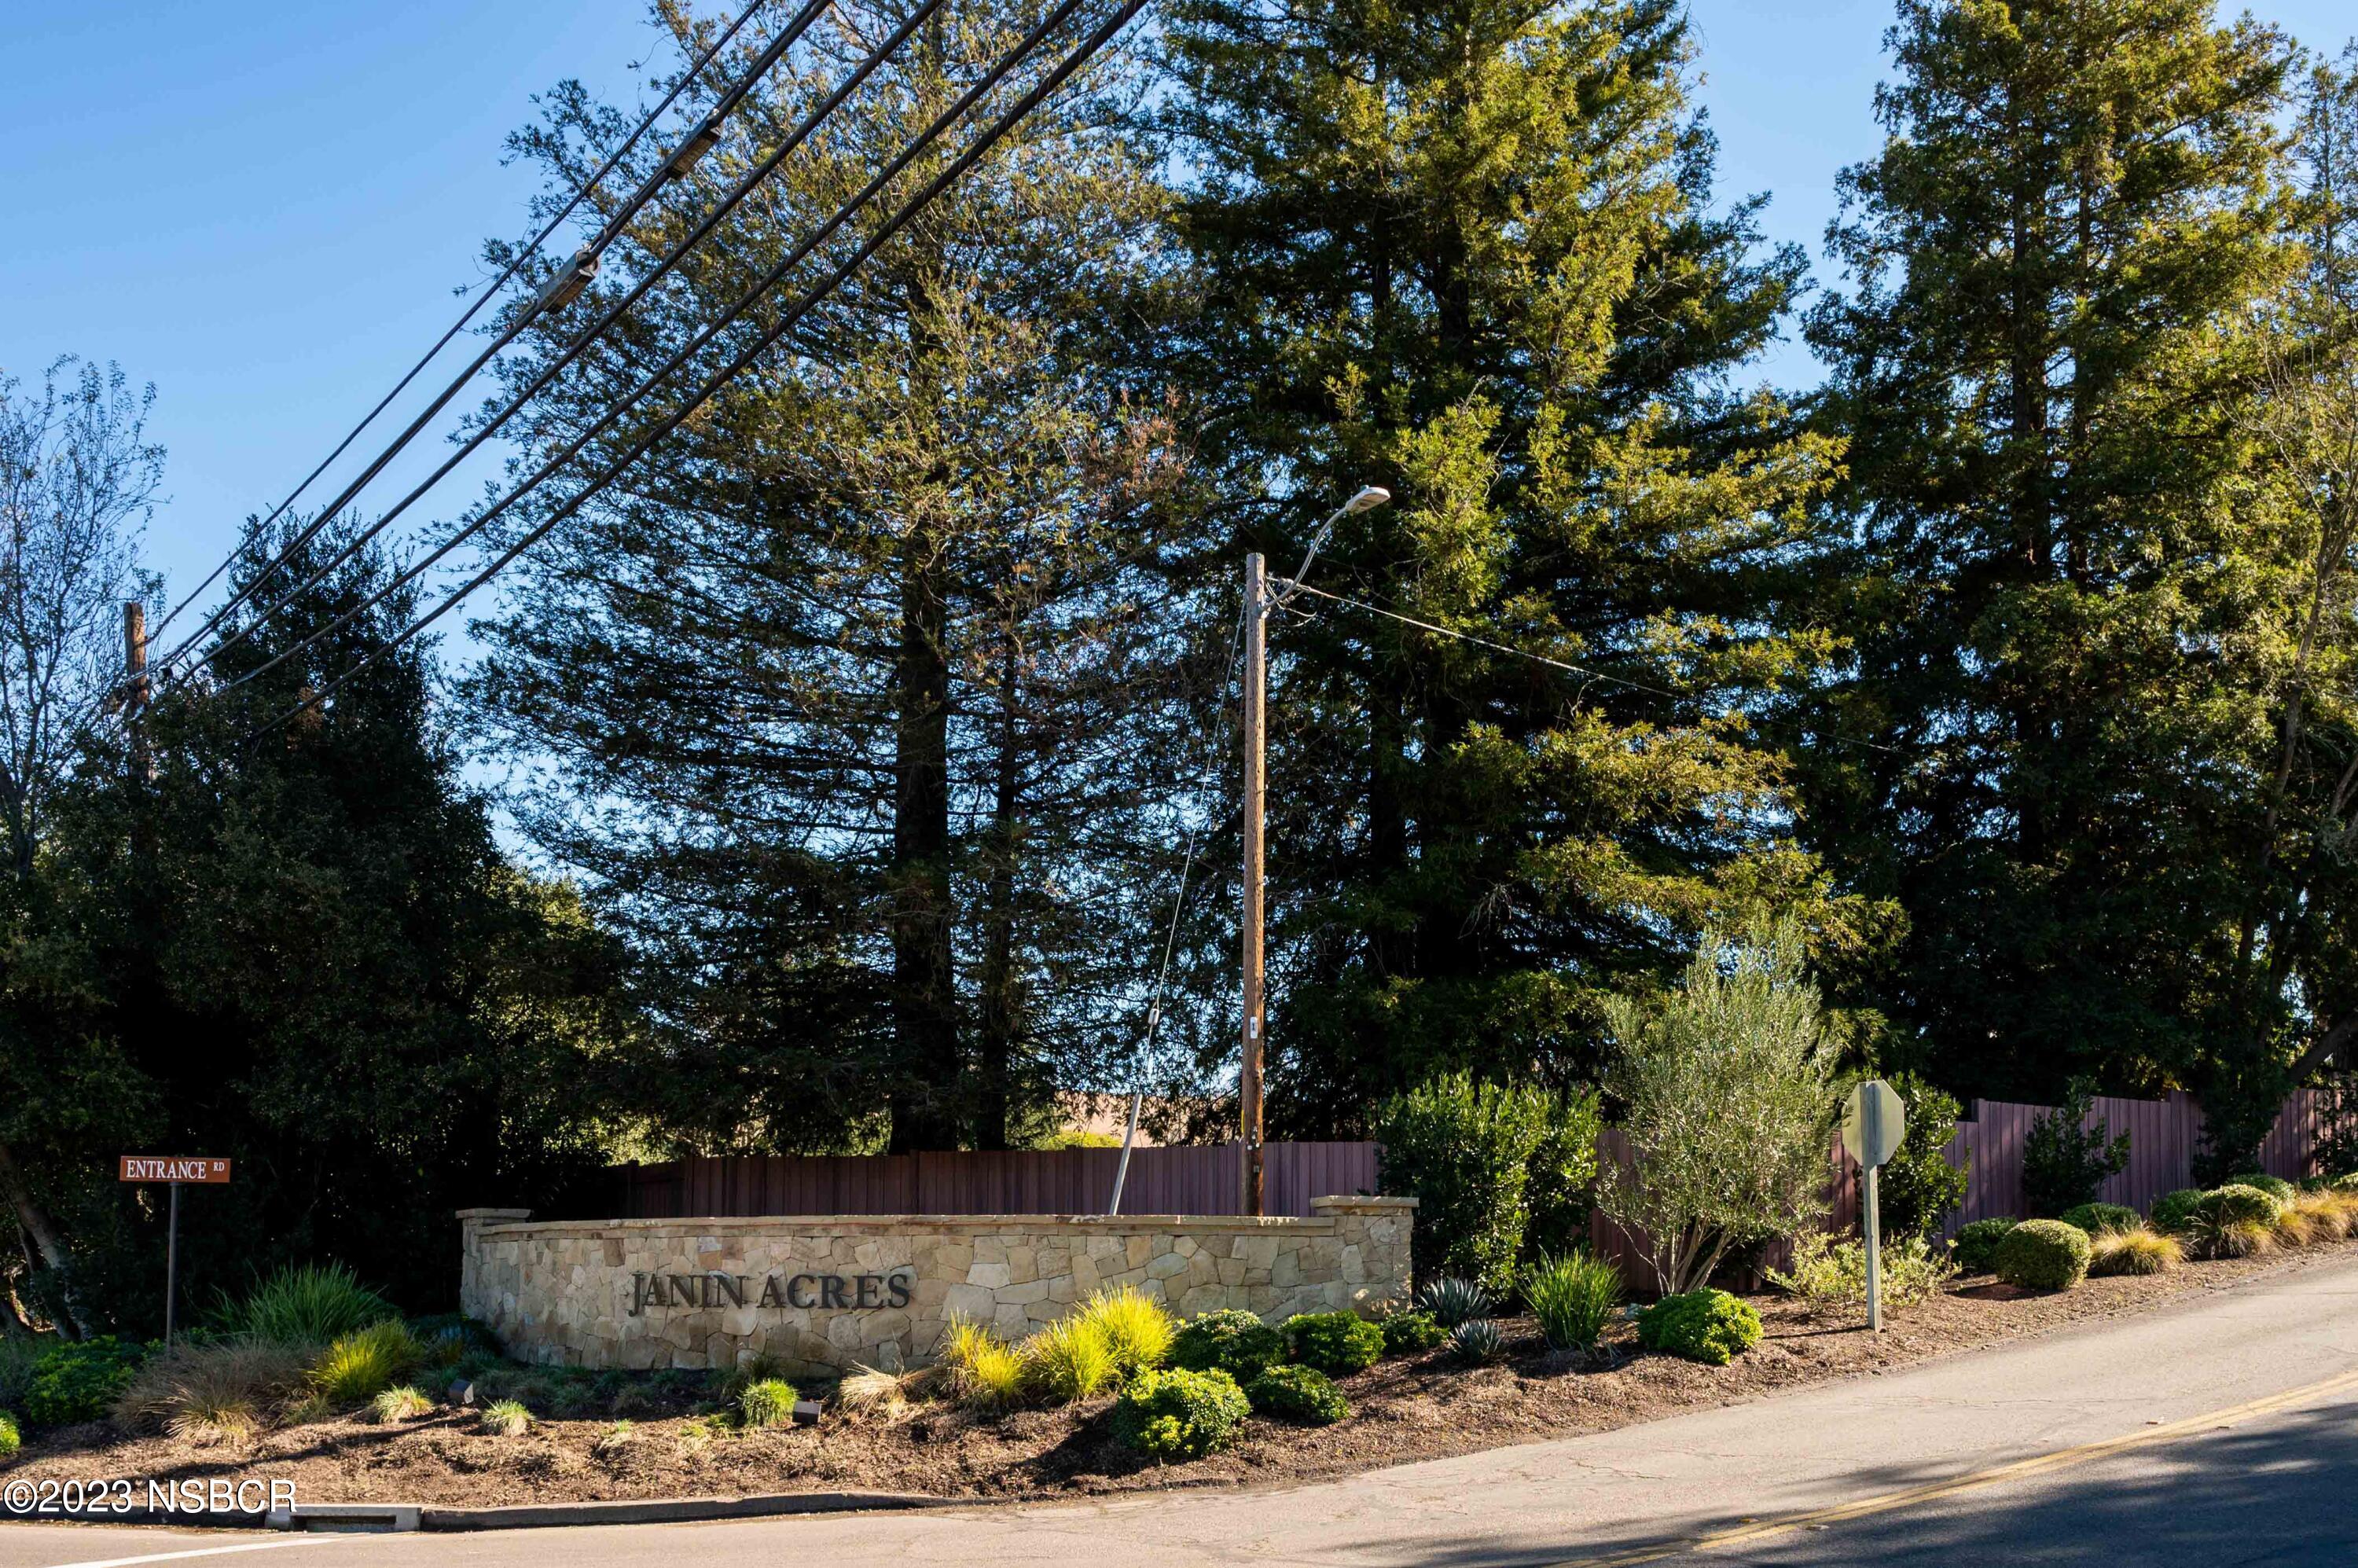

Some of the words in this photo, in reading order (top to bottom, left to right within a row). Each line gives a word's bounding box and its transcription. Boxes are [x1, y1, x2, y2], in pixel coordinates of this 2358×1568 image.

[126, 1160, 207, 1179] ENTRANCE
[213, 1162, 225, 1172] RD
[628, 1271, 750, 1317] JANIN
[756, 1273, 910, 1309] ACRES
